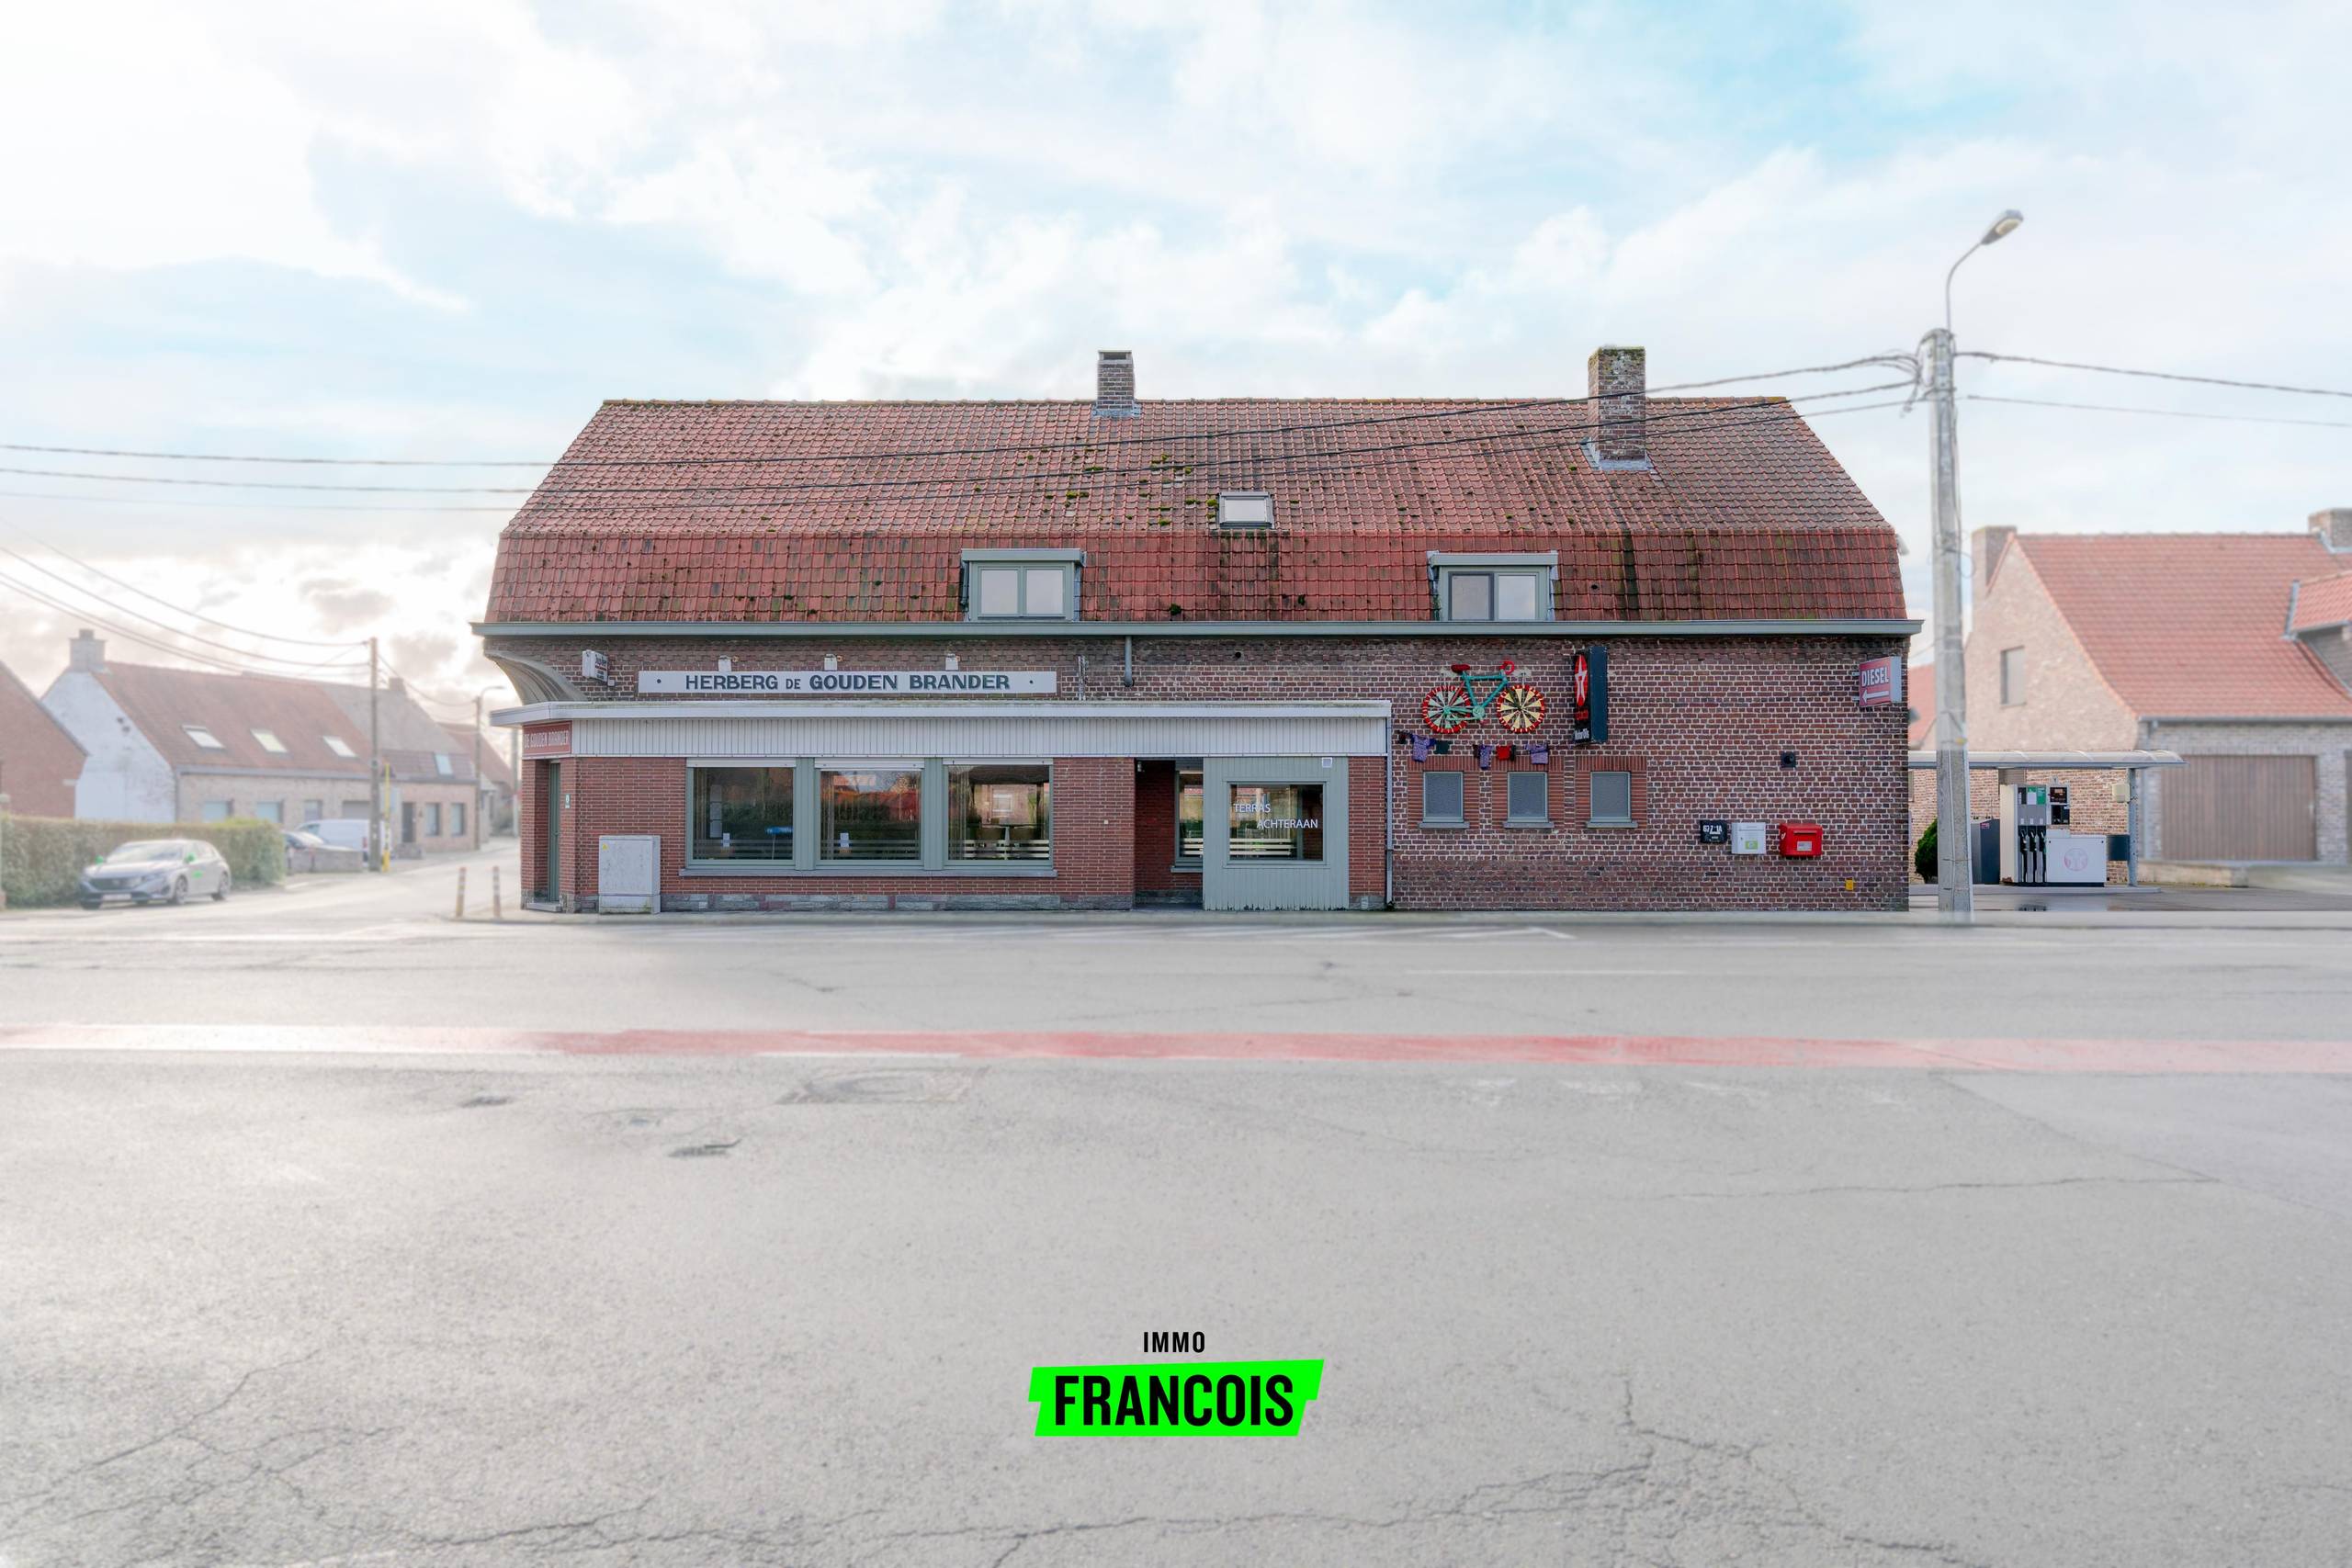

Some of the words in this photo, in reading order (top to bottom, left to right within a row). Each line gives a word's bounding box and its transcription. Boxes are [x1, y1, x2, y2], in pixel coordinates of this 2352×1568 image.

[685, 675, 778, 690] HERBERG
[786, 678, 801, 690] DE
[809, 675, 898, 690] GOUDEN
[909, 674, 1010, 690] BRANDER
[1861, 667, 1889, 687] DIESEL
[1234, 803, 1272, 814] TERRAS
[1257, 818, 1318, 829] ACHTERAAN
